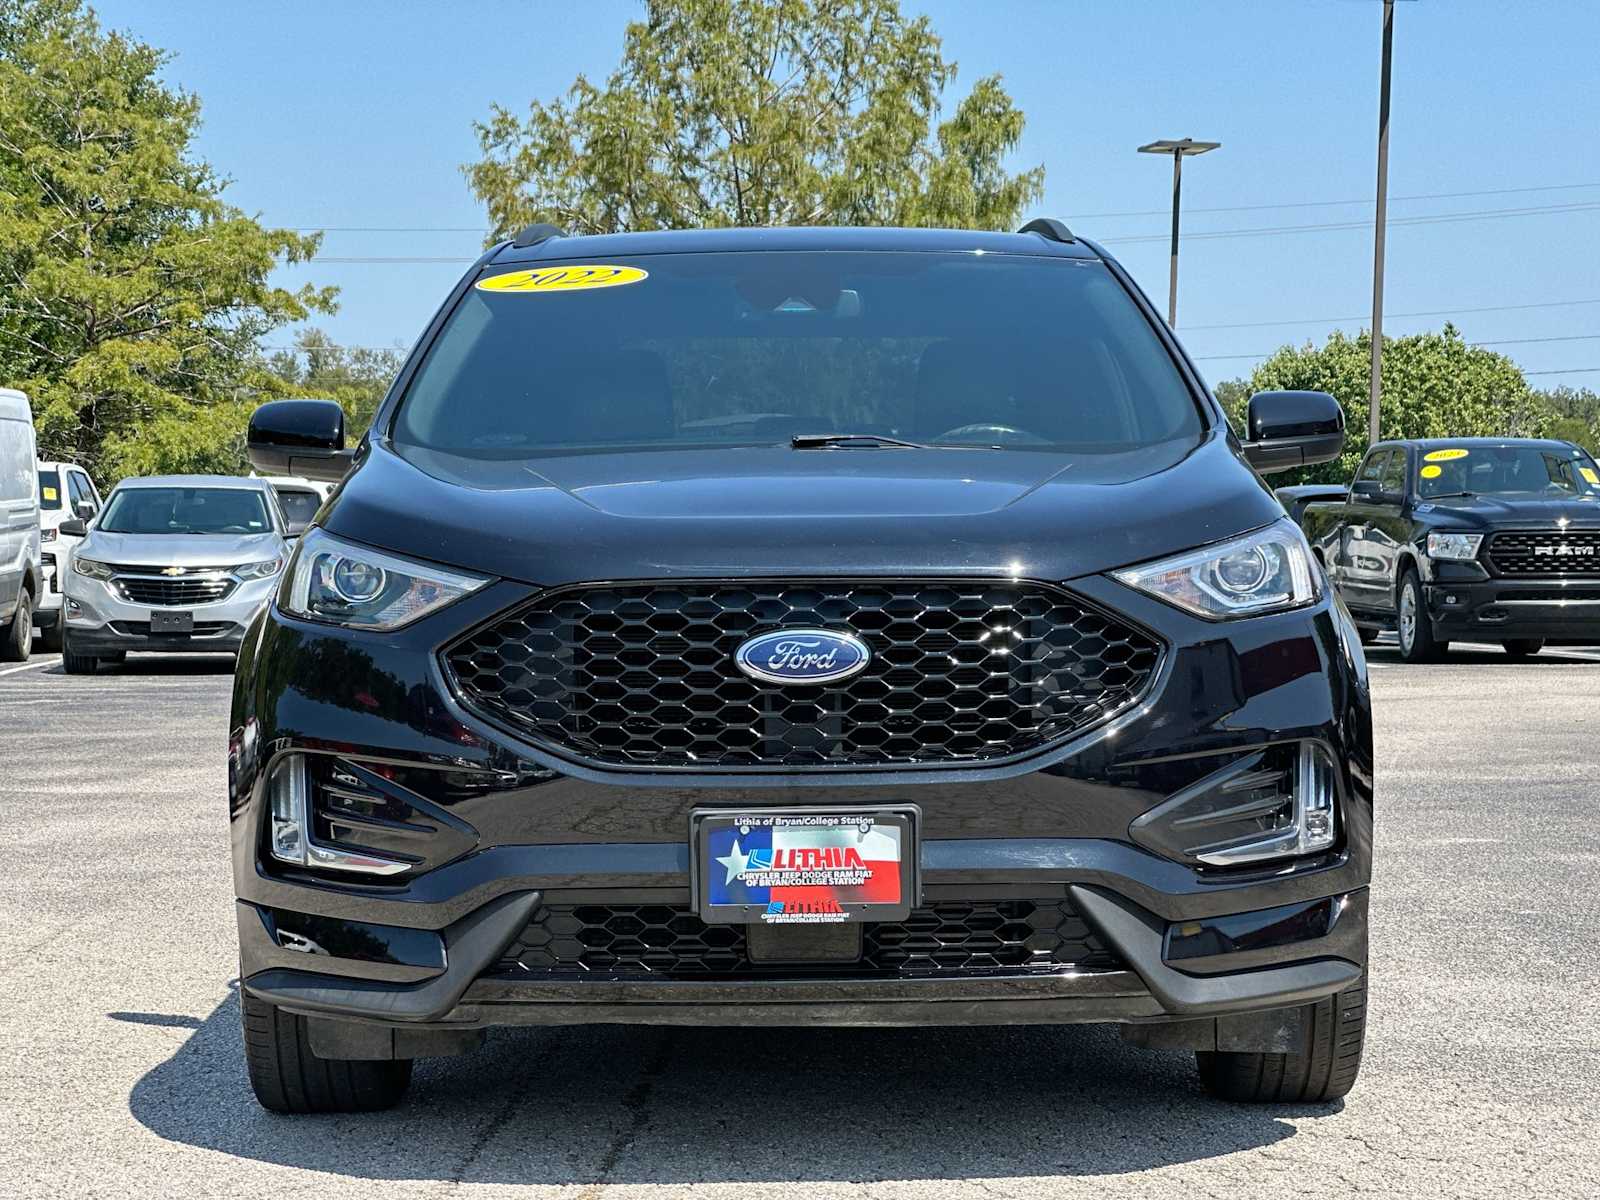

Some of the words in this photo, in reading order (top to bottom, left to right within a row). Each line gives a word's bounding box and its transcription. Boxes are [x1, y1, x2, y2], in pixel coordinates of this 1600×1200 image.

[500, 269, 622, 289] 2022
[1534, 545, 1594, 556] RAM
[767, 640, 838, 670] Ford
[734, 816, 760, 826] Lithia
[762, 816, 773, 826] of
[775, 816, 839, 827] Bryan/College
[840, 815, 875, 825] Station
[773, 847, 865, 869] LITHIA
[736, 870, 780, 880] CHRYSLER
[780, 870, 801, 879] JEEP
[802, 870, 833, 879] DODGE
[833, 869, 855, 879] RAM
[855, 869, 874, 878] FIAT
[745, 879, 757, 887] OF
[758, 879, 828, 887] BRYAN/COLLEGE
[829, 877, 865, 886] STATION
